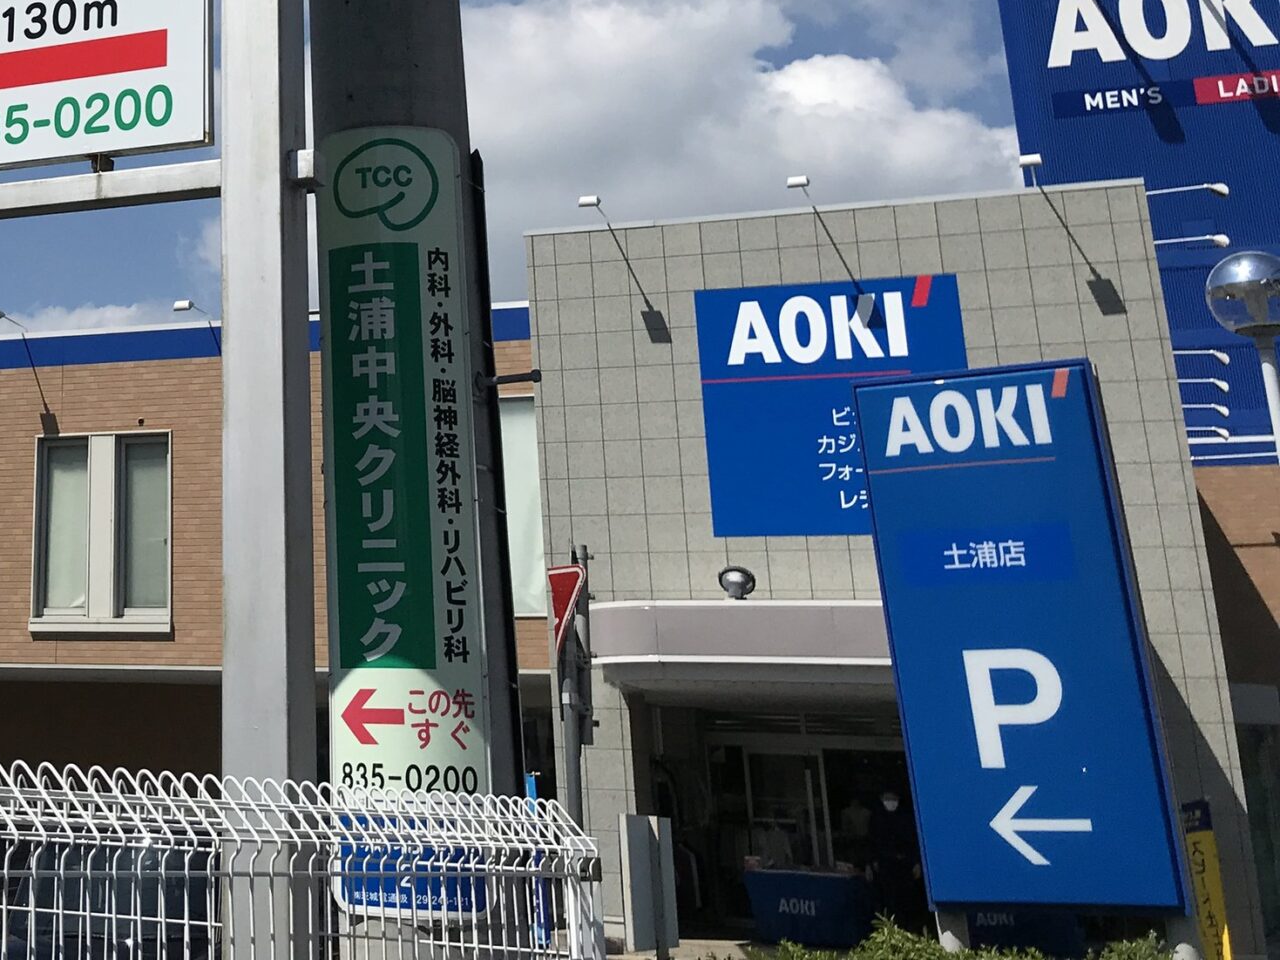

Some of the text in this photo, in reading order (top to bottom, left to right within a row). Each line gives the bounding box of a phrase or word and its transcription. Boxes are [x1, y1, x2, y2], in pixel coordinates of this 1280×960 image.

[1084, 87, 1163, 111] MEN'S
[355, 165, 413, 189] TCC
[727, 290, 909, 366] AOKI
[885, 383, 1053, 458] AOKI
[347, 251, 407, 662] 土浦中央クリニック
[427, 247, 470, 663] 内科・外科・脳神経外科・リハビリ科
[943, 540, 1026, 571] 土浦店
[408, 689, 475, 719] この先
[962, 648, 1063, 769] P
[411, 718, 471, 751] すぐ
[342, 762, 478, 794] 835-0200
[779, 897, 816, 917] AOKI
